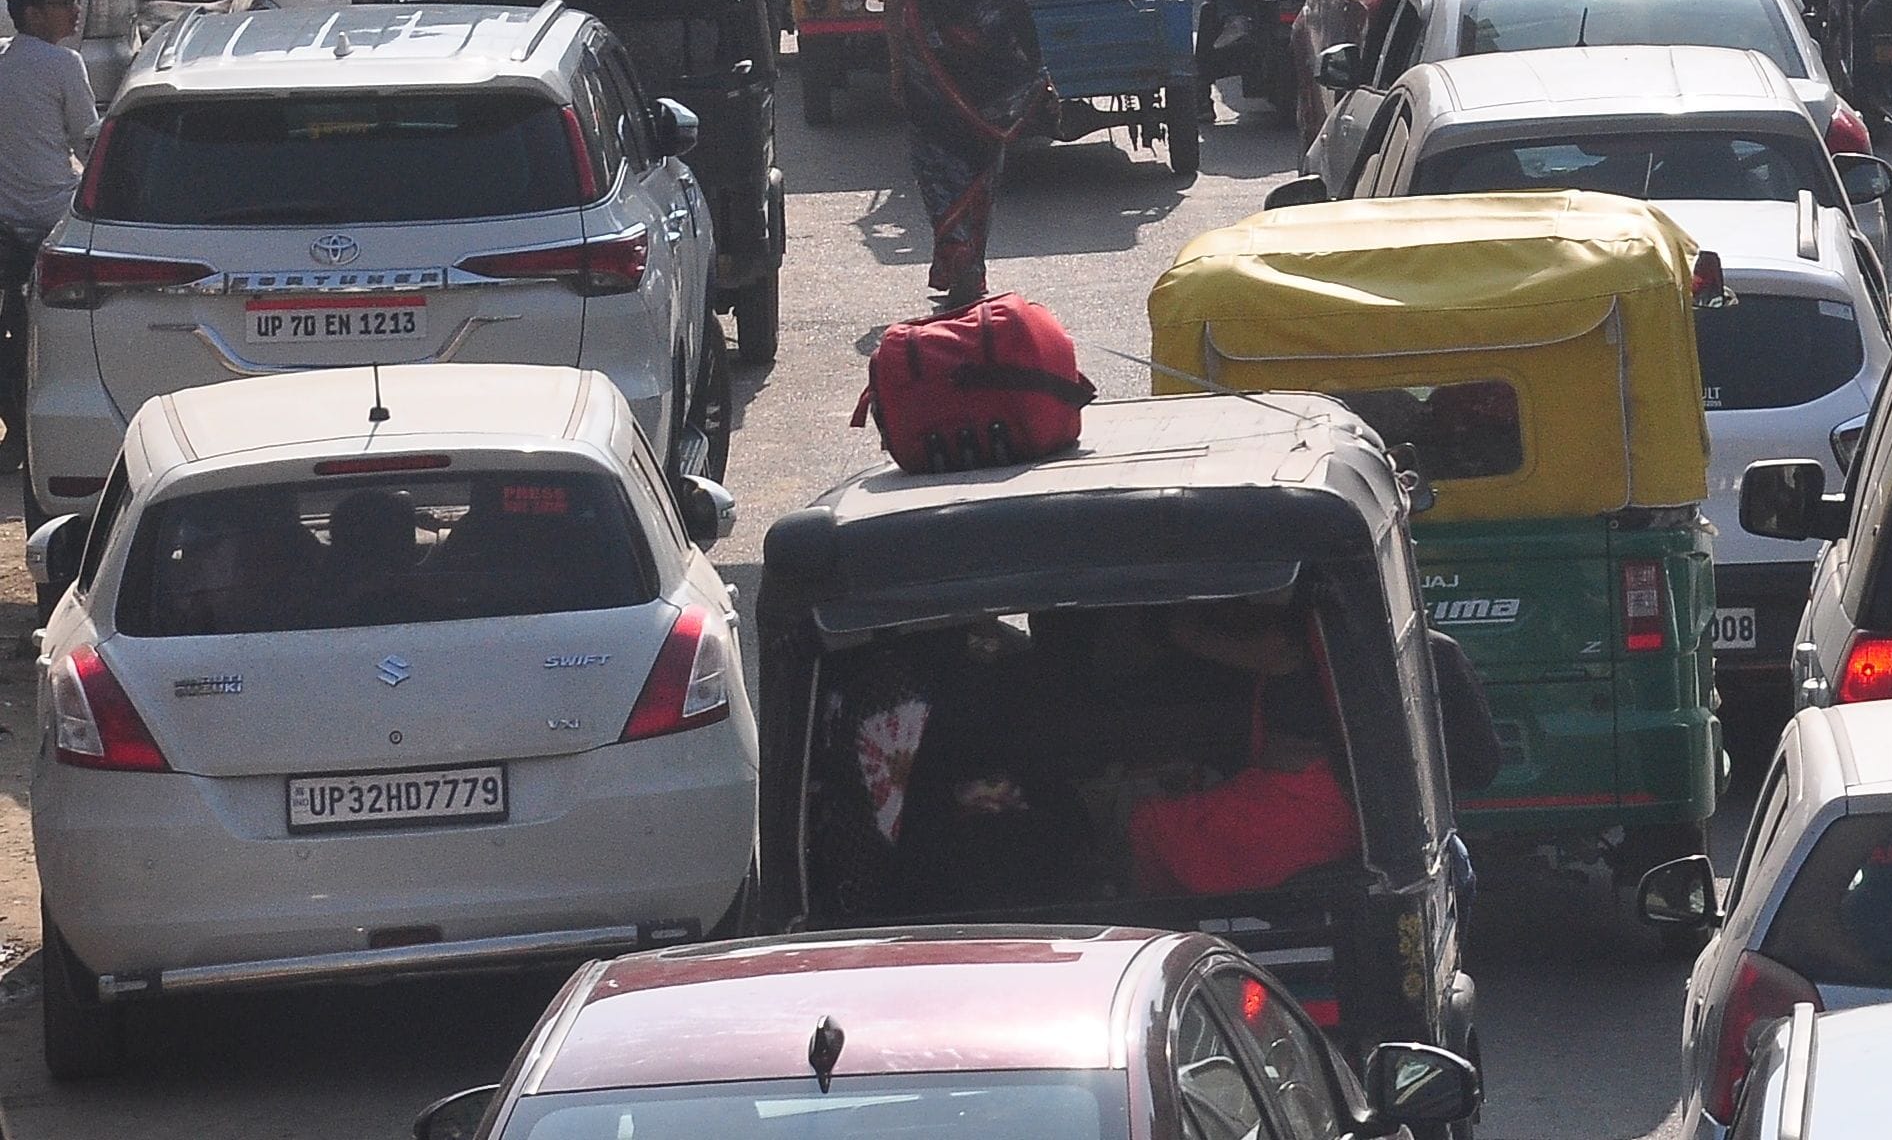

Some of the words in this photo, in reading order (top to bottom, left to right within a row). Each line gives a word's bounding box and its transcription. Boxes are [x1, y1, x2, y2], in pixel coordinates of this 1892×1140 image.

[256, 314, 283, 338] UP
[290, 314, 316, 337] 70
[324, 313, 352, 336] EN
[359, 311, 416, 335] 1213
[543, 654, 610, 669] SWIFT
[310, 775, 499, 817] UP32HD7779
